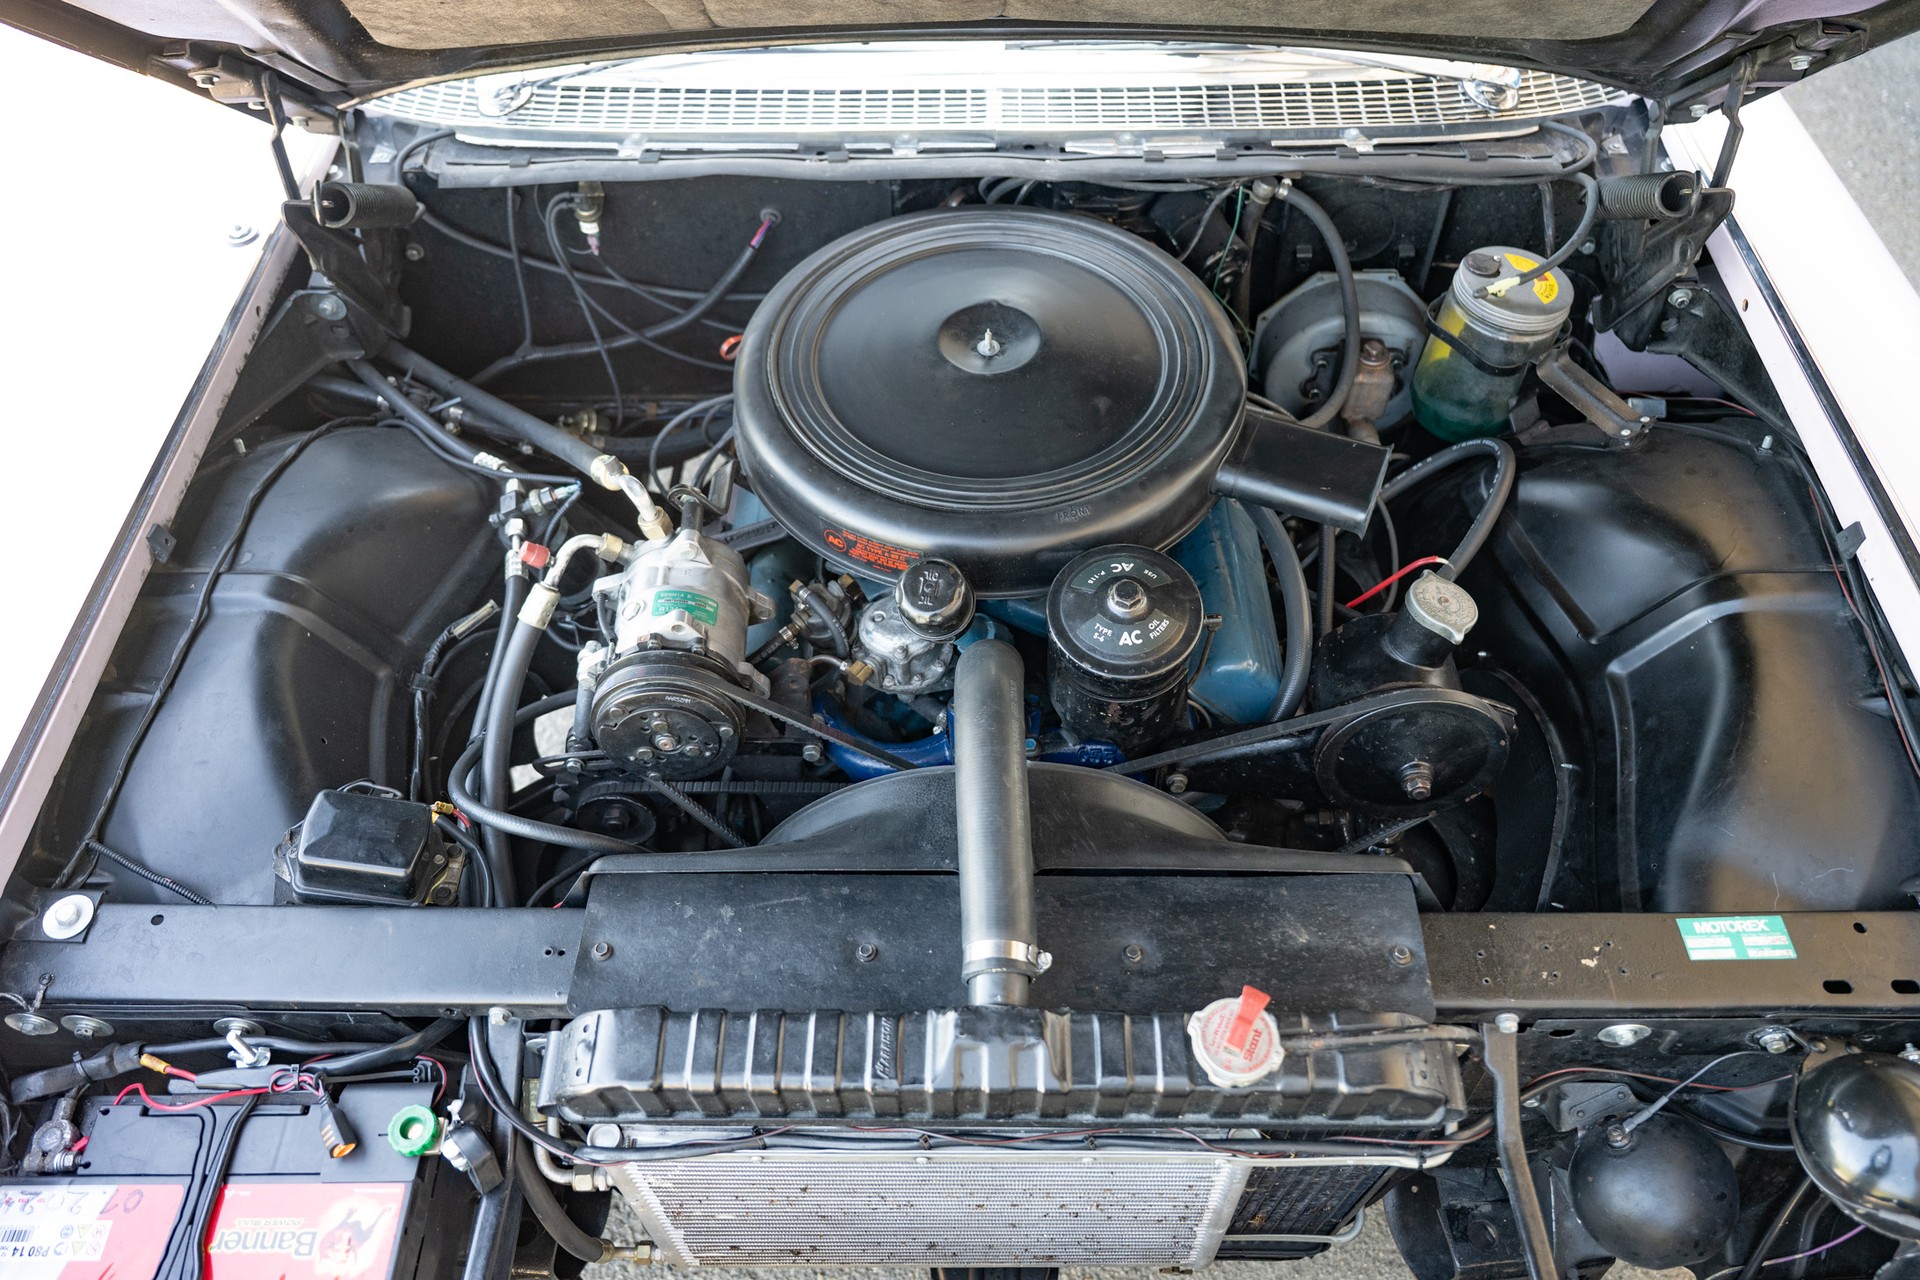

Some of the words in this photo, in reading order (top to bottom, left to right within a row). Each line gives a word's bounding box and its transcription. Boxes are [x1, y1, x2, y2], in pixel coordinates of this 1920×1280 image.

[1110, 562, 1134, 573] AC
[1143, 569, 1157, 579] USE
[1094, 622, 1113, 637] TYPE
[1148, 619, 1160, 630] OIL
[1149, 618, 1170, 640] FILTERS
[1093, 632, 1105, 642] S-6
[1119, 630, 1143, 646] AC
[1693, 919, 1770, 934] MOTOREX
[874, 1016, 892, 1079] HARRISON
[1243, 1028, 1262, 1062] Stant
[11, 1245, 25, 1257] 14
[28, 1245, 50, 1257] P80
[209, 1230, 318, 1257] Banner
